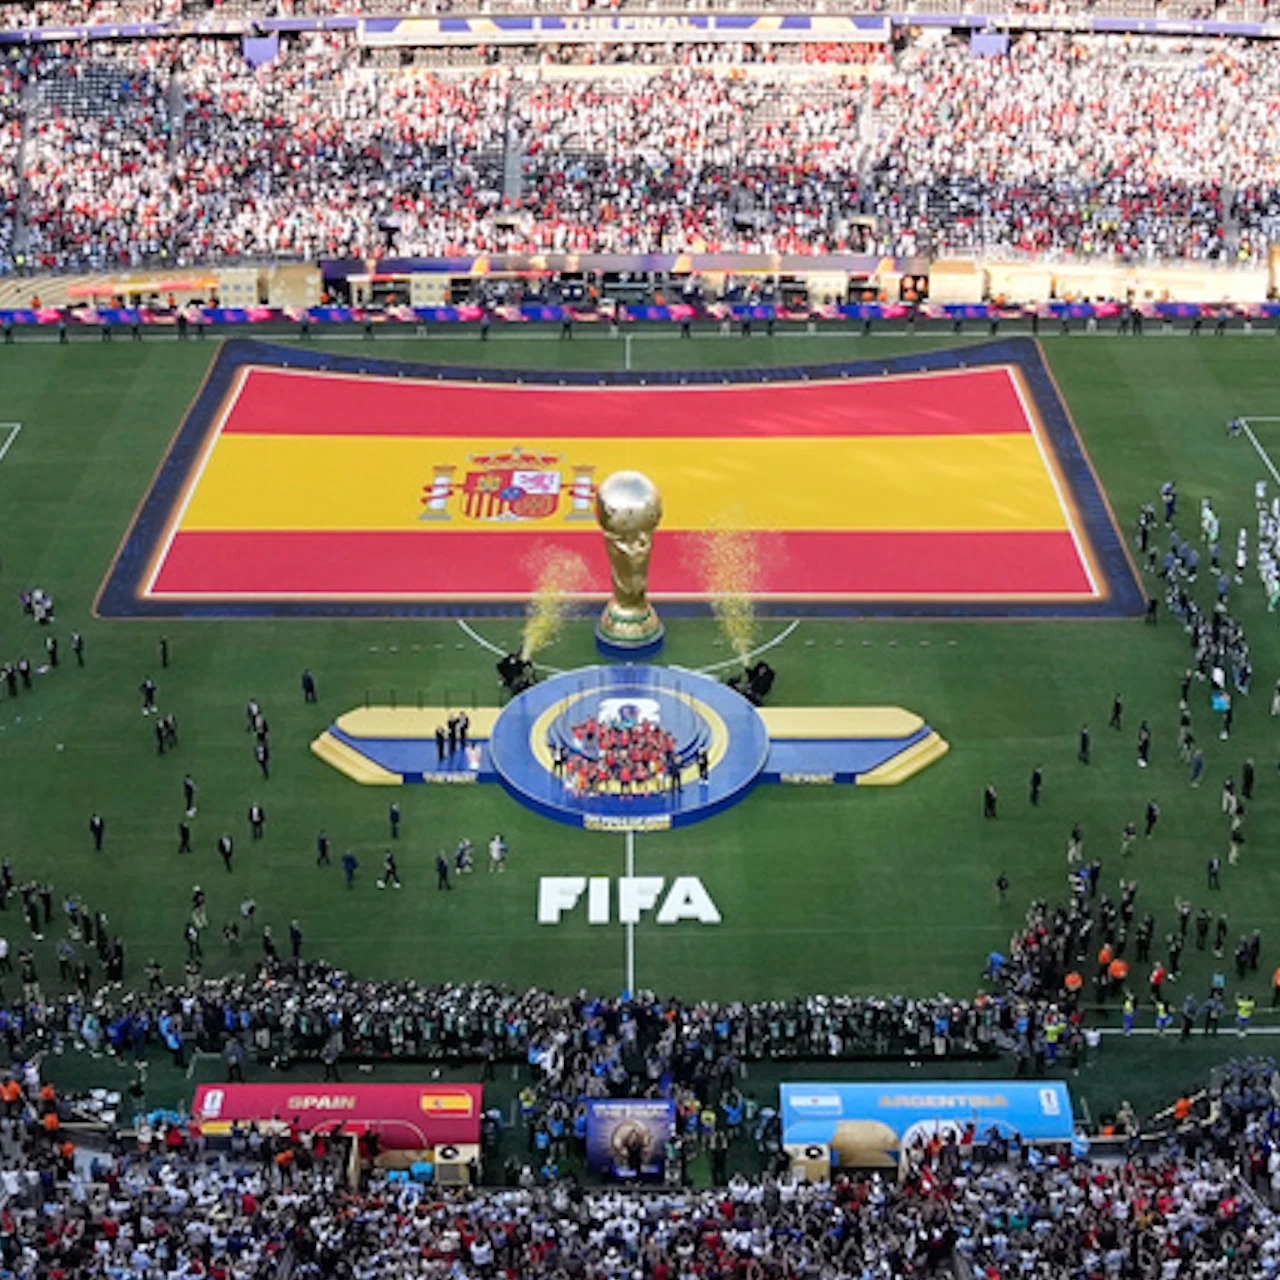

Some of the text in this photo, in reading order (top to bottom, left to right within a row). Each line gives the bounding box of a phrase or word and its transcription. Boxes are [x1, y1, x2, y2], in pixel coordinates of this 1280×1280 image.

[564, 17, 697, 29] THE FINAL
[538, 877, 721, 924] FIFA
[288, 1095, 356, 1110] SPAIN
[879, 1094, 1008, 1108] ARGENTINA
